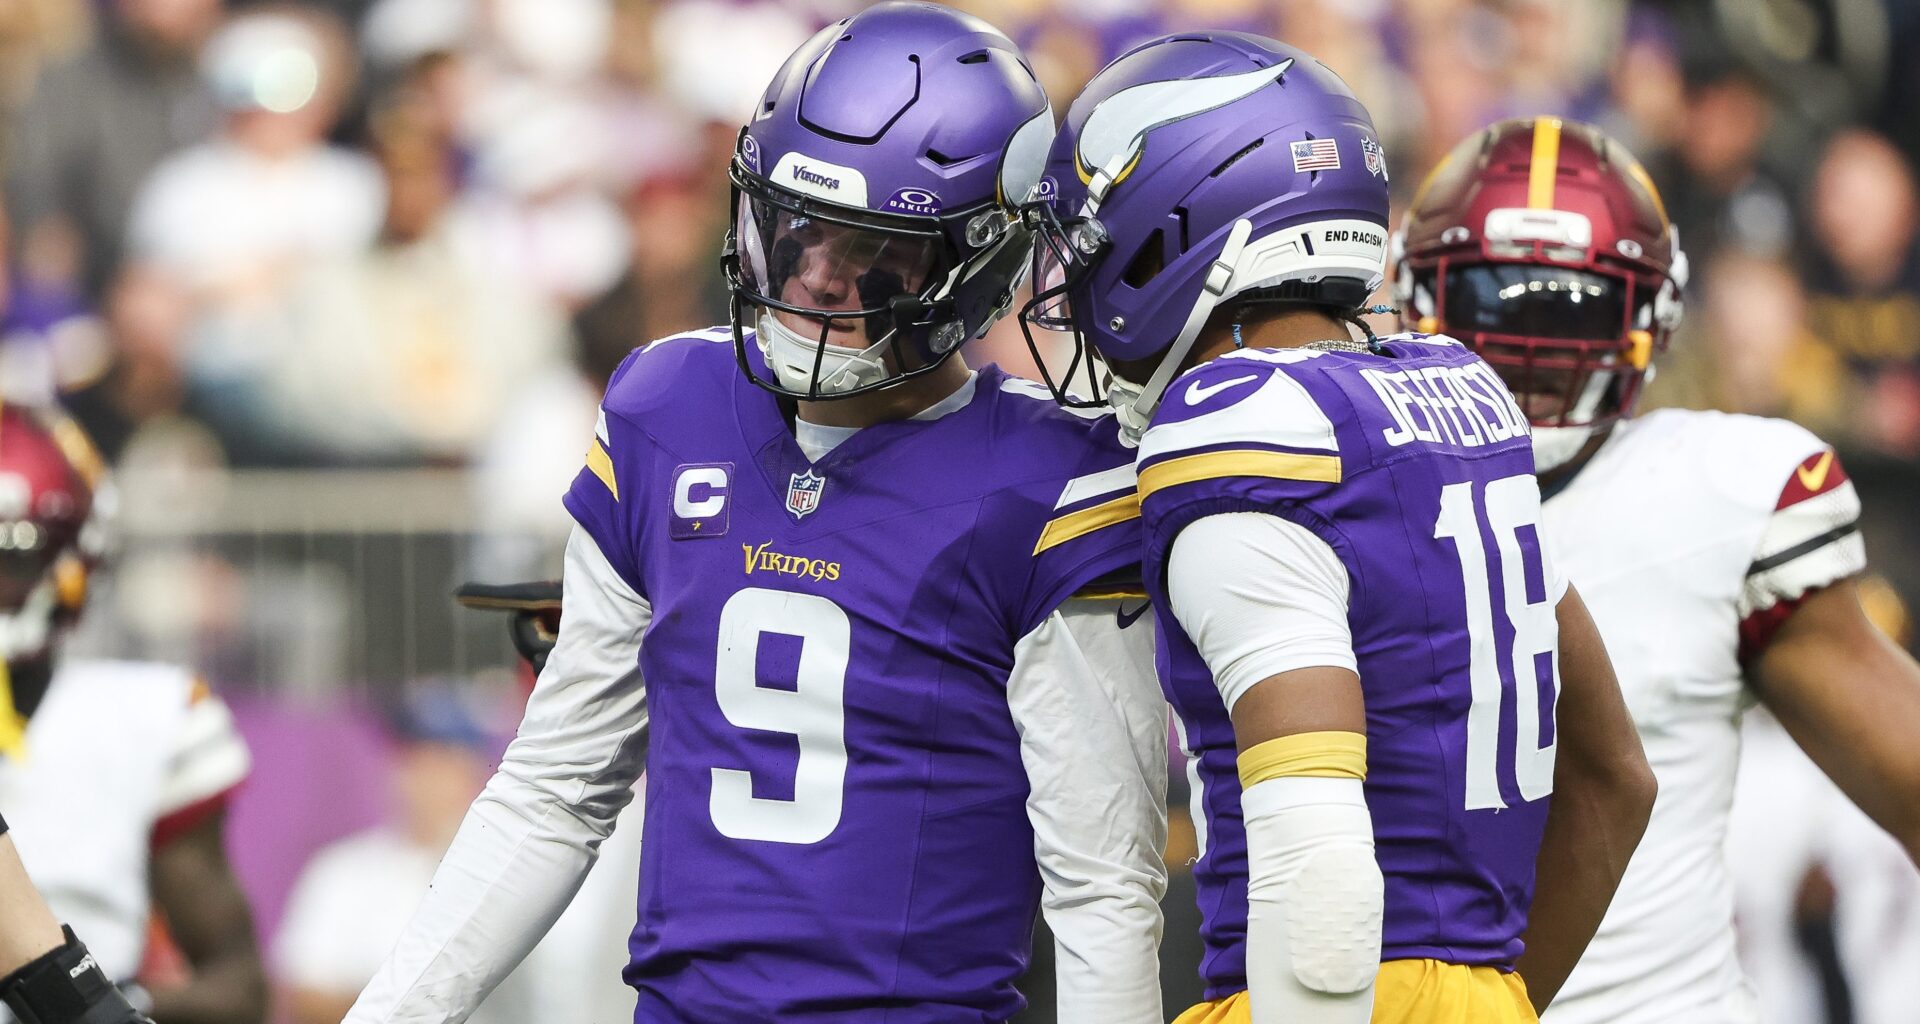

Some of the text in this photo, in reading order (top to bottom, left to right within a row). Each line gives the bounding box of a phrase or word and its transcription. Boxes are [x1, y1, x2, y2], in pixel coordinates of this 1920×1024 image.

[889, 200, 938, 214] OAKLEY
[1325, 230, 1383, 249] END RACISM
[673, 467, 728, 519] C
[791, 489, 814, 510] NFL
[1433, 473, 1562, 813] 18
[709, 587, 851, 845] 9
